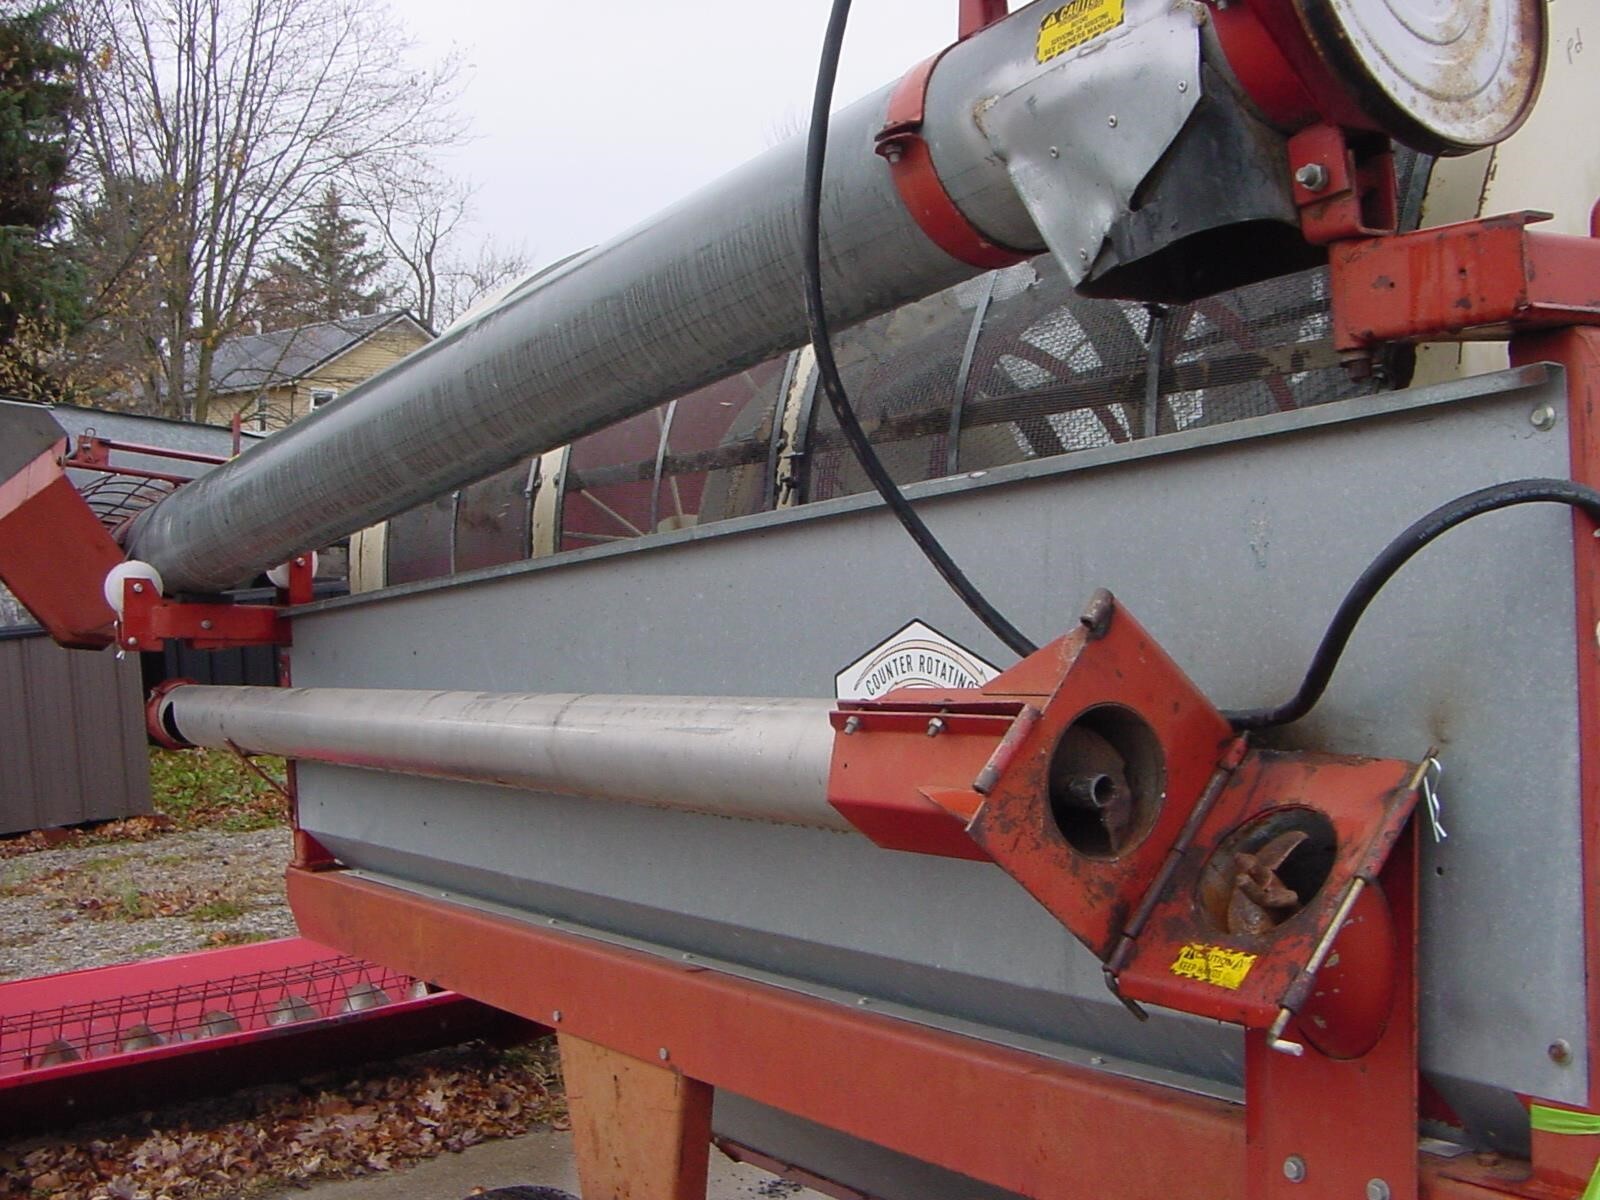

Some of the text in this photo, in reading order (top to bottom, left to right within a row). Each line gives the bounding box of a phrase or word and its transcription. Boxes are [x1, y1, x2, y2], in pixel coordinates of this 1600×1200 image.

[1044, 17, 1114, 56] SEE OWNERS MANUAL
[866, 654, 913, 695] COUNTER
[1180, 961, 1196, 972] KEEP
